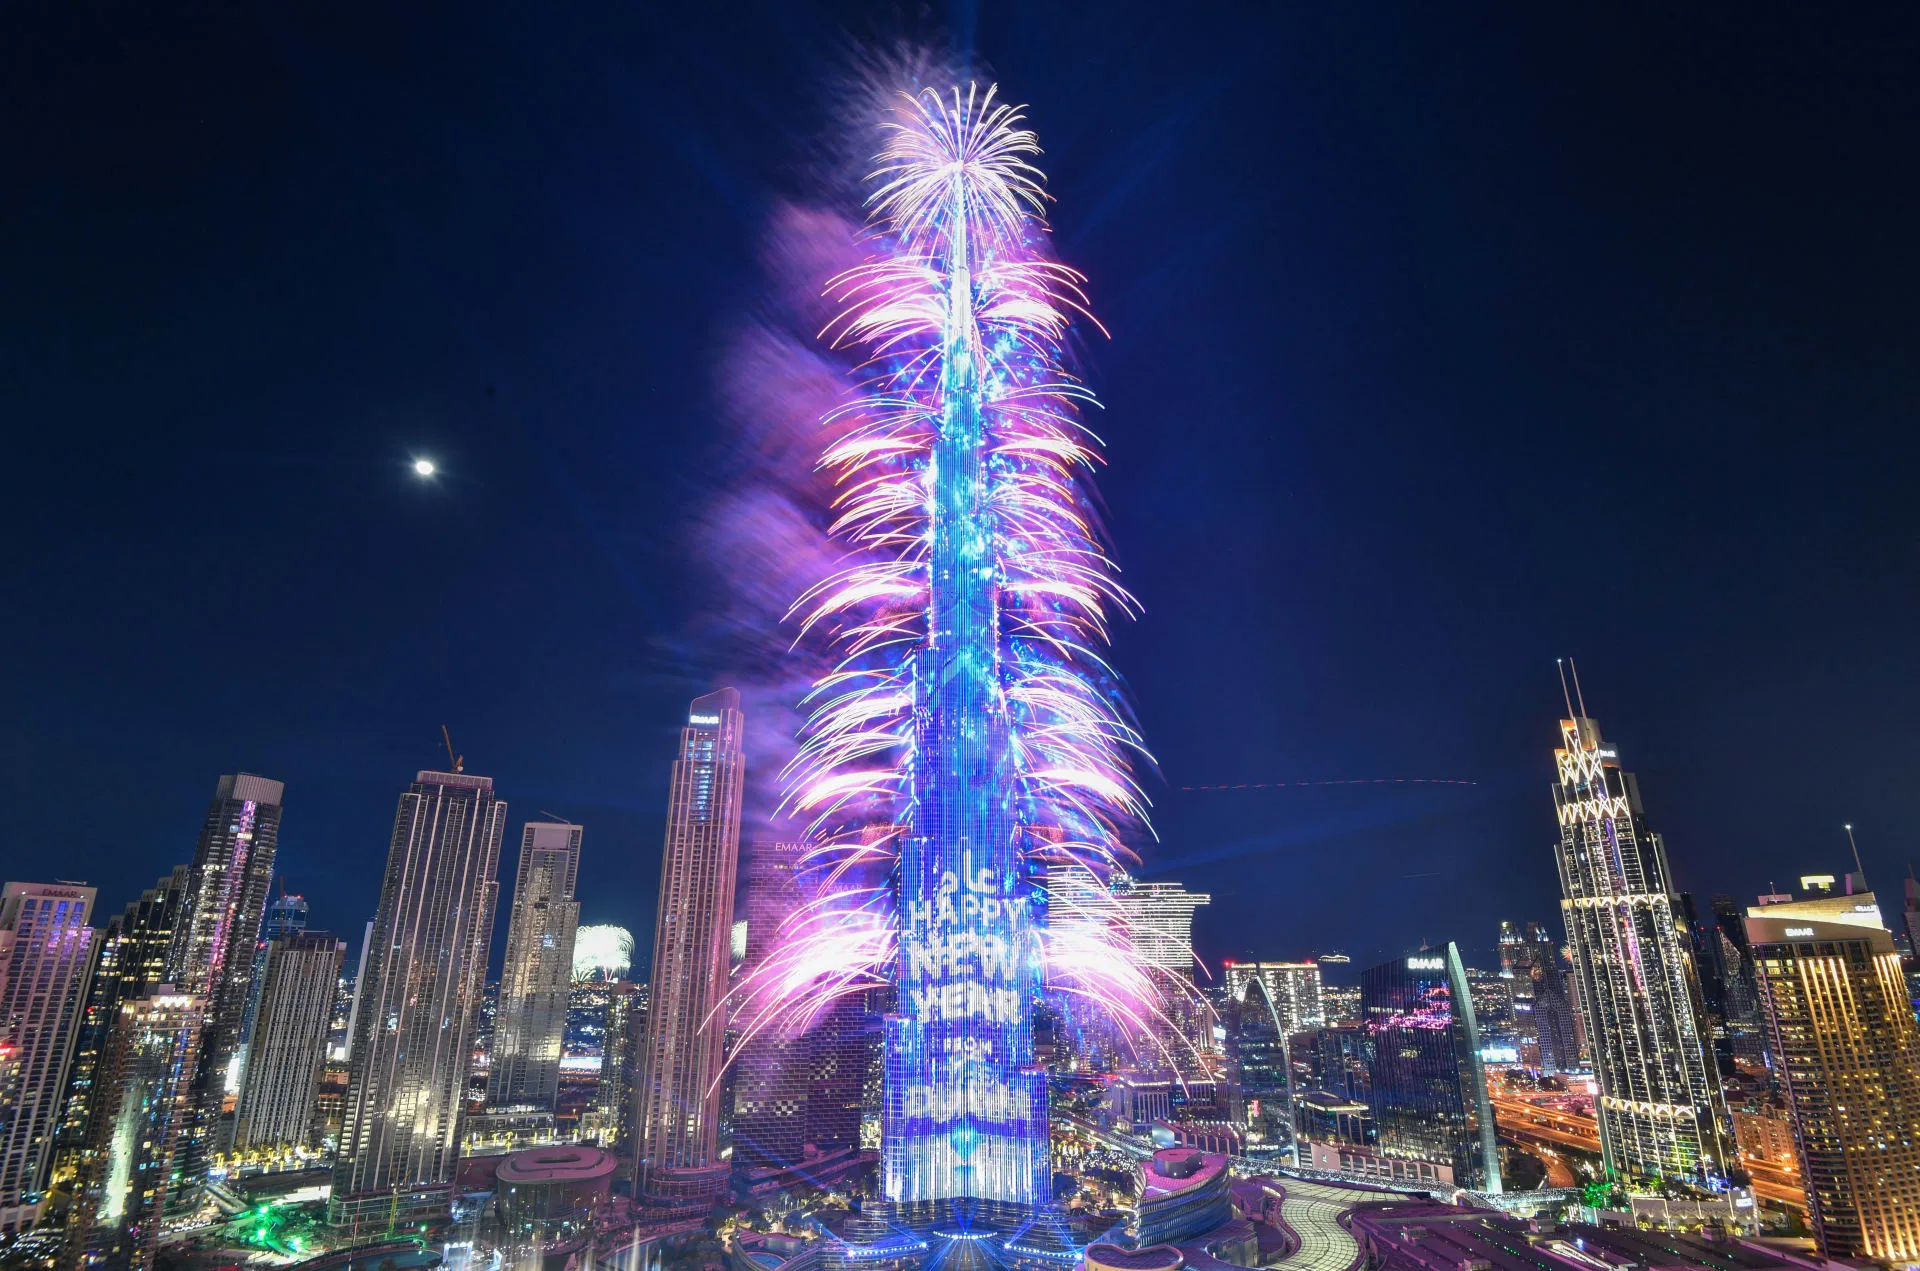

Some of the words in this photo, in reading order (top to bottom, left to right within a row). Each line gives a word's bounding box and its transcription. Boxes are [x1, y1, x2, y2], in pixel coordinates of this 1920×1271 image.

[775, 842, 812, 852] EMAAR
[908, 893, 1028, 932] HAPPY
[907, 932, 1022, 981] NEW
[1408, 957, 1445, 970] EMAAR
[909, 980, 1021, 1026] YEAR
